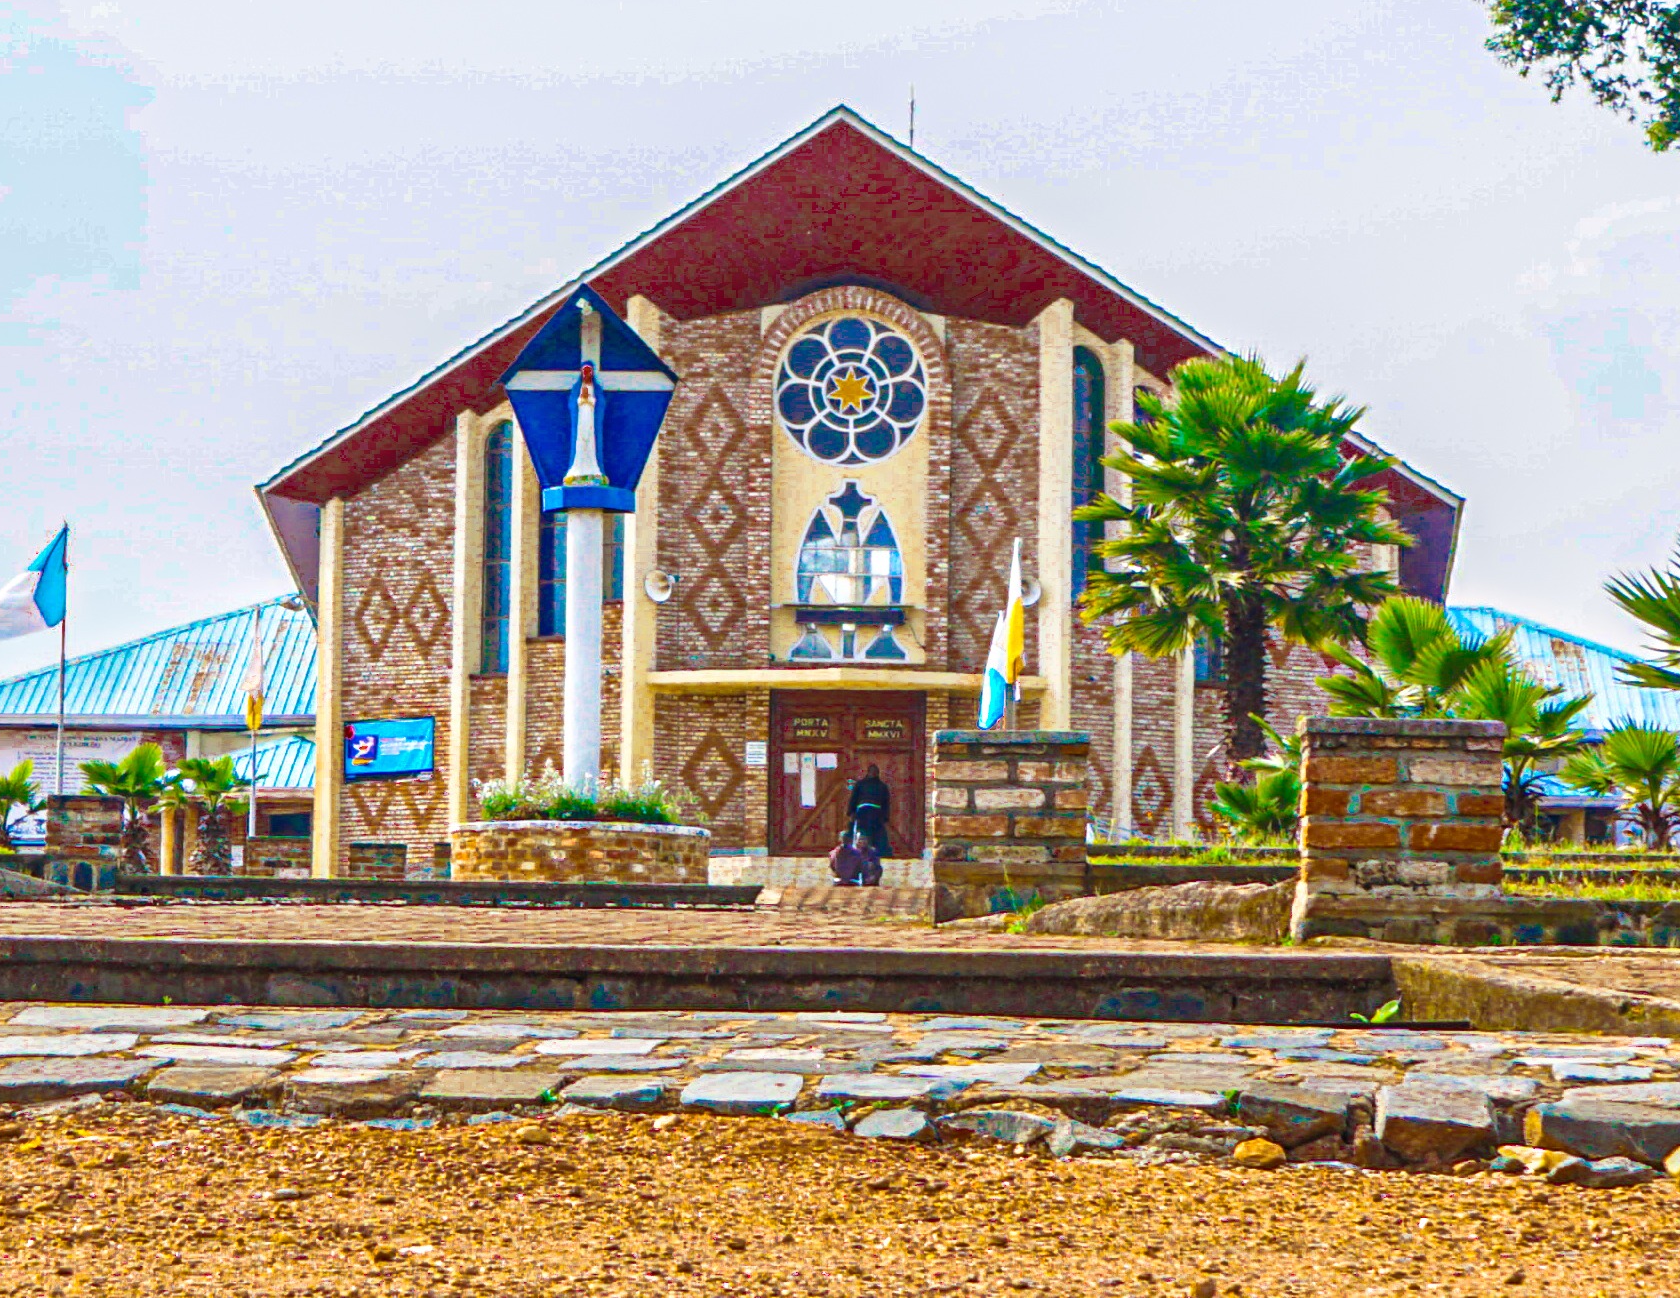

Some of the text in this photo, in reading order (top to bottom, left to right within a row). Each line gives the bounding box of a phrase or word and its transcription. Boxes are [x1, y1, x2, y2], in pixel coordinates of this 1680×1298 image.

[793, 717, 829, 727] PORTA
[864, 719, 903, 728] SANCTA
[795, 729, 828, 737] MMXV
[867, 730, 901, 738] MMXVI
